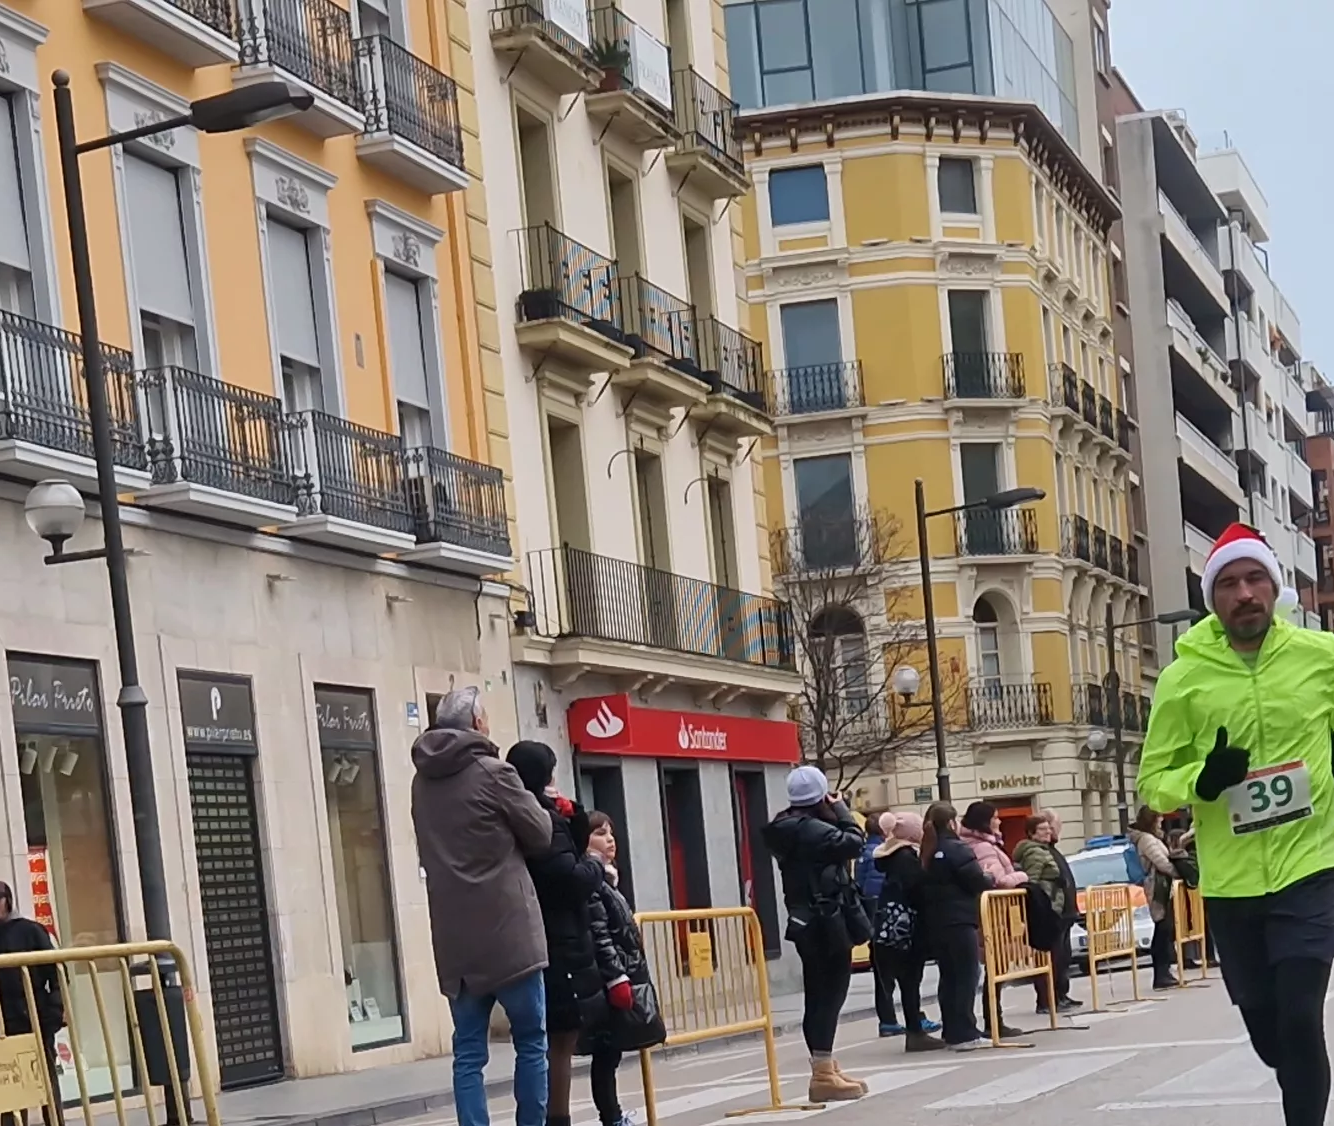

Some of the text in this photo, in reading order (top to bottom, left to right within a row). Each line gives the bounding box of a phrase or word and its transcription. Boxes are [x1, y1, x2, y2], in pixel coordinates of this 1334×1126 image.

[10, 676, 94, 713] Pilar Prieto
[688, 723, 728, 751] Santander
[979, 774, 1042, 791] bankinter
[1247, 774, 1293, 813] 39
